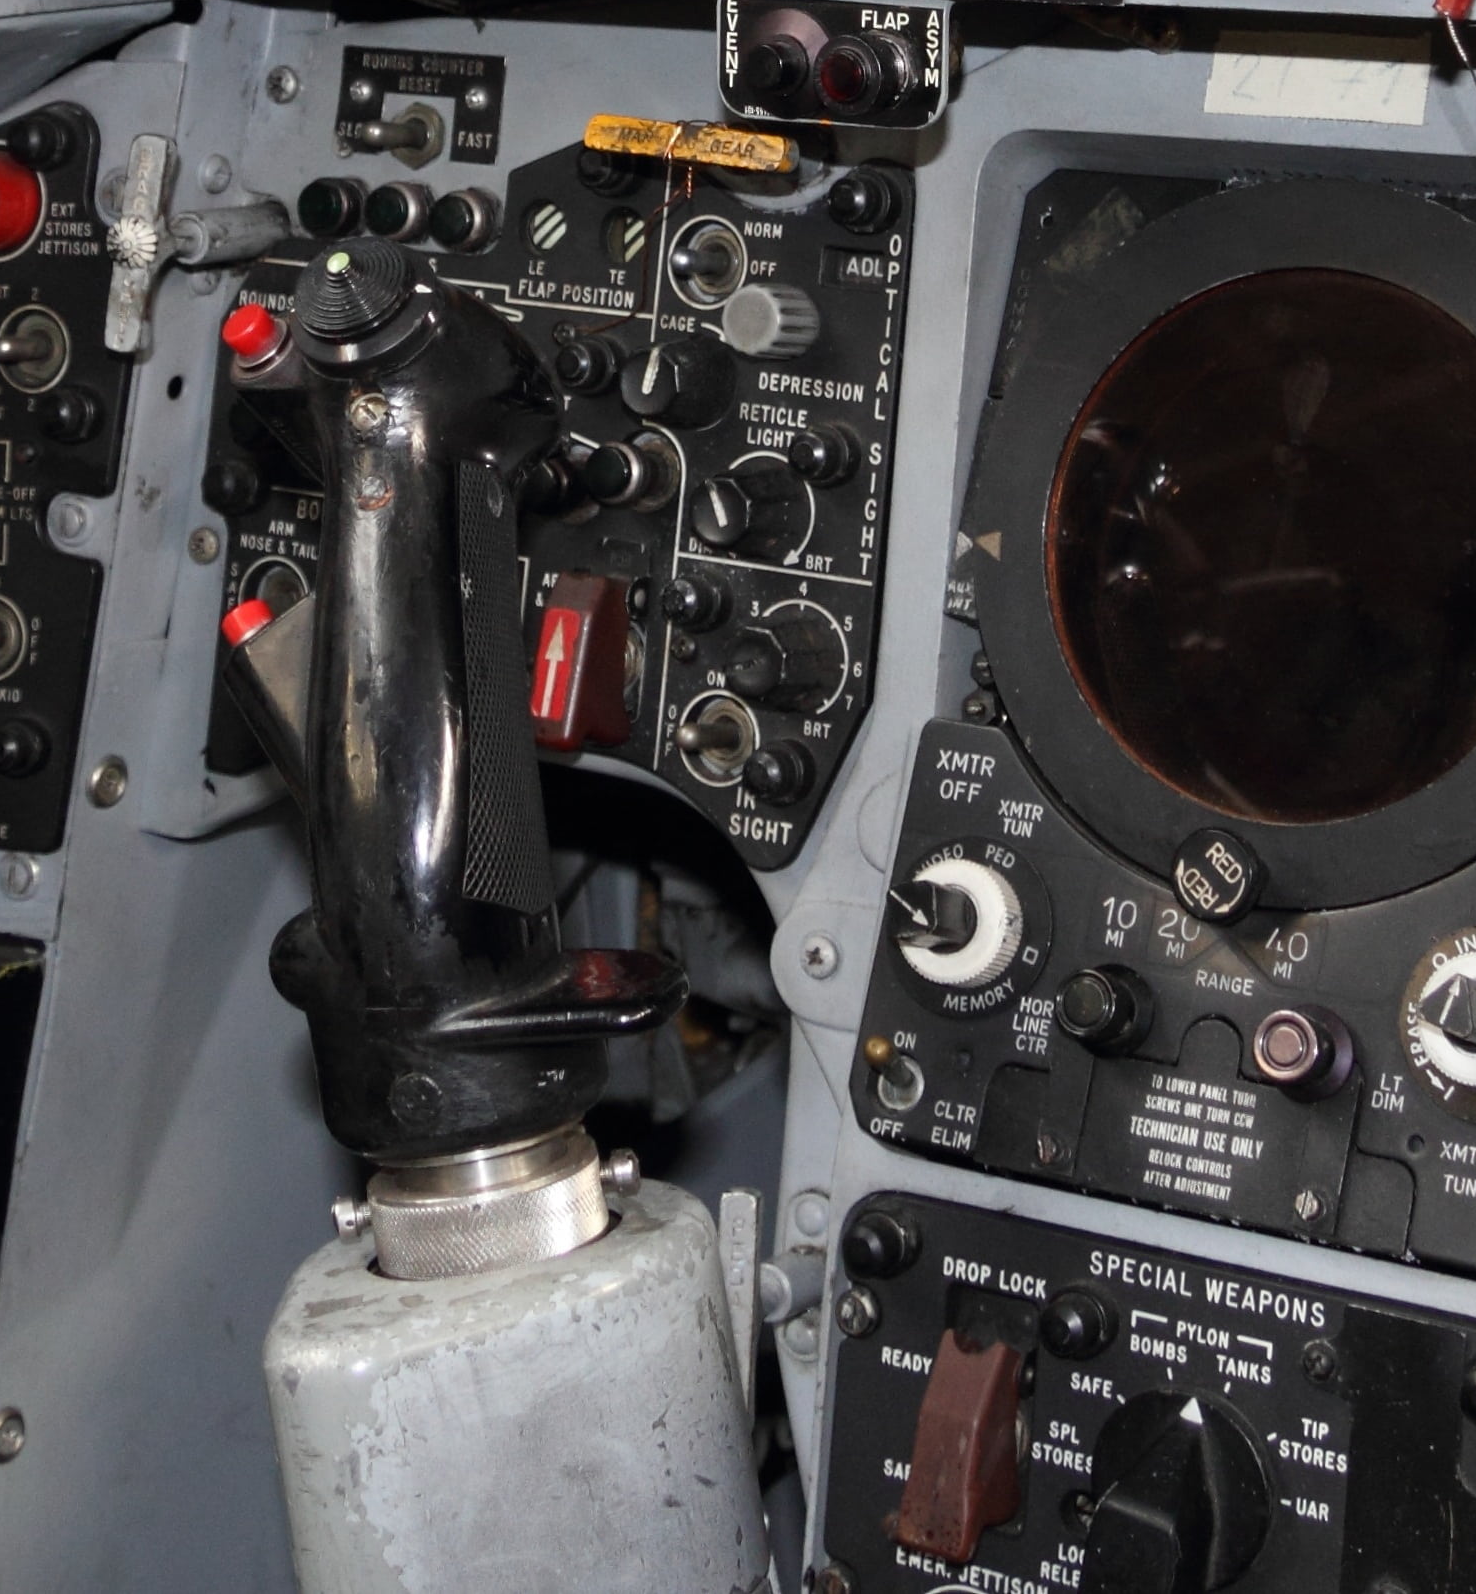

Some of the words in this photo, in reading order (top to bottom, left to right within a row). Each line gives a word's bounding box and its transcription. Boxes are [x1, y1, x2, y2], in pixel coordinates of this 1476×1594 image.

[860, 11, 910, 29] FLAP
[458, 131, 492, 148] FAST
[51, 203, 75, 217] EXT
[45, 222, 91, 237] STORES
[744, 222, 782, 238] NORM
[37, 241, 98, 256] JETTISON
[750, 261, 777, 275] OFF
[518, 281, 556, 298] FLAP
[562, 286, 634, 307] POSITION
[660, 316, 695, 332] CAGE
[875, 234, 902, 420] OPTICAL
[759, 373, 864, 402] DEPRESSION
[740, 405, 807, 428] RETICLE
[937, 749, 995, 777] XMTR
[939, 779, 982, 803] OFF
[998, 799, 1043, 822] XMTR
[729, 814, 793, 845] SIGHT
[1003, 818, 1033, 838] TUN
[1195, 969, 1253, 996] RANGE
[943, 978, 1014, 1013] MEMORY
[1012, 1015, 1050, 1037] LINE
[1015, 1035, 1047, 1055] CTR
[934, 1100, 976, 1124] CLTR
[1145, 1094, 1181, 1114] SCREWS
[1184, 1102, 1203, 1119] ONE
[1207, 1106, 1230, 1124] TURN
[1234, 1112, 1254, 1129] CCW
[1372, 1091, 1405, 1112] DIM
[931, 1126, 971, 1150] ELIM
[1130, 1115, 1199, 1147] TECHNICIAN
[1203, 1131, 1227, 1153] USE
[1231, 1136, 1263, 1160] ONLY
[1149, 1149, 1183, 1169] RELOCK
[1186, 1156, 1232, 1179] CONTROLS
[1143, 1170, 1171, 1188] AFTER
[1174, 1176, 1231, 1201] ADJUSTMENT
[943, 1256, 991, 1284] DROP
[999, 1269, 1046, 1299] LOCK
[1089, 1251, 1193, 1298] SPECIAL
[1205, 1279, 1326, 1327] WEAPONS
[1176, 1320, 1229, 1349] PYLON
[1130, 1334, 1187, 1363] BOMBS
[1216, 1354, 1273, 1385] TANKS
[1070, 1372, 1113, 1398] SAFE
[1049, 1422, 1080, 1445] SPL
[1301, 1418, 1329, 1438] TIP
[1279, 1438, 1348, 1473] STORES
